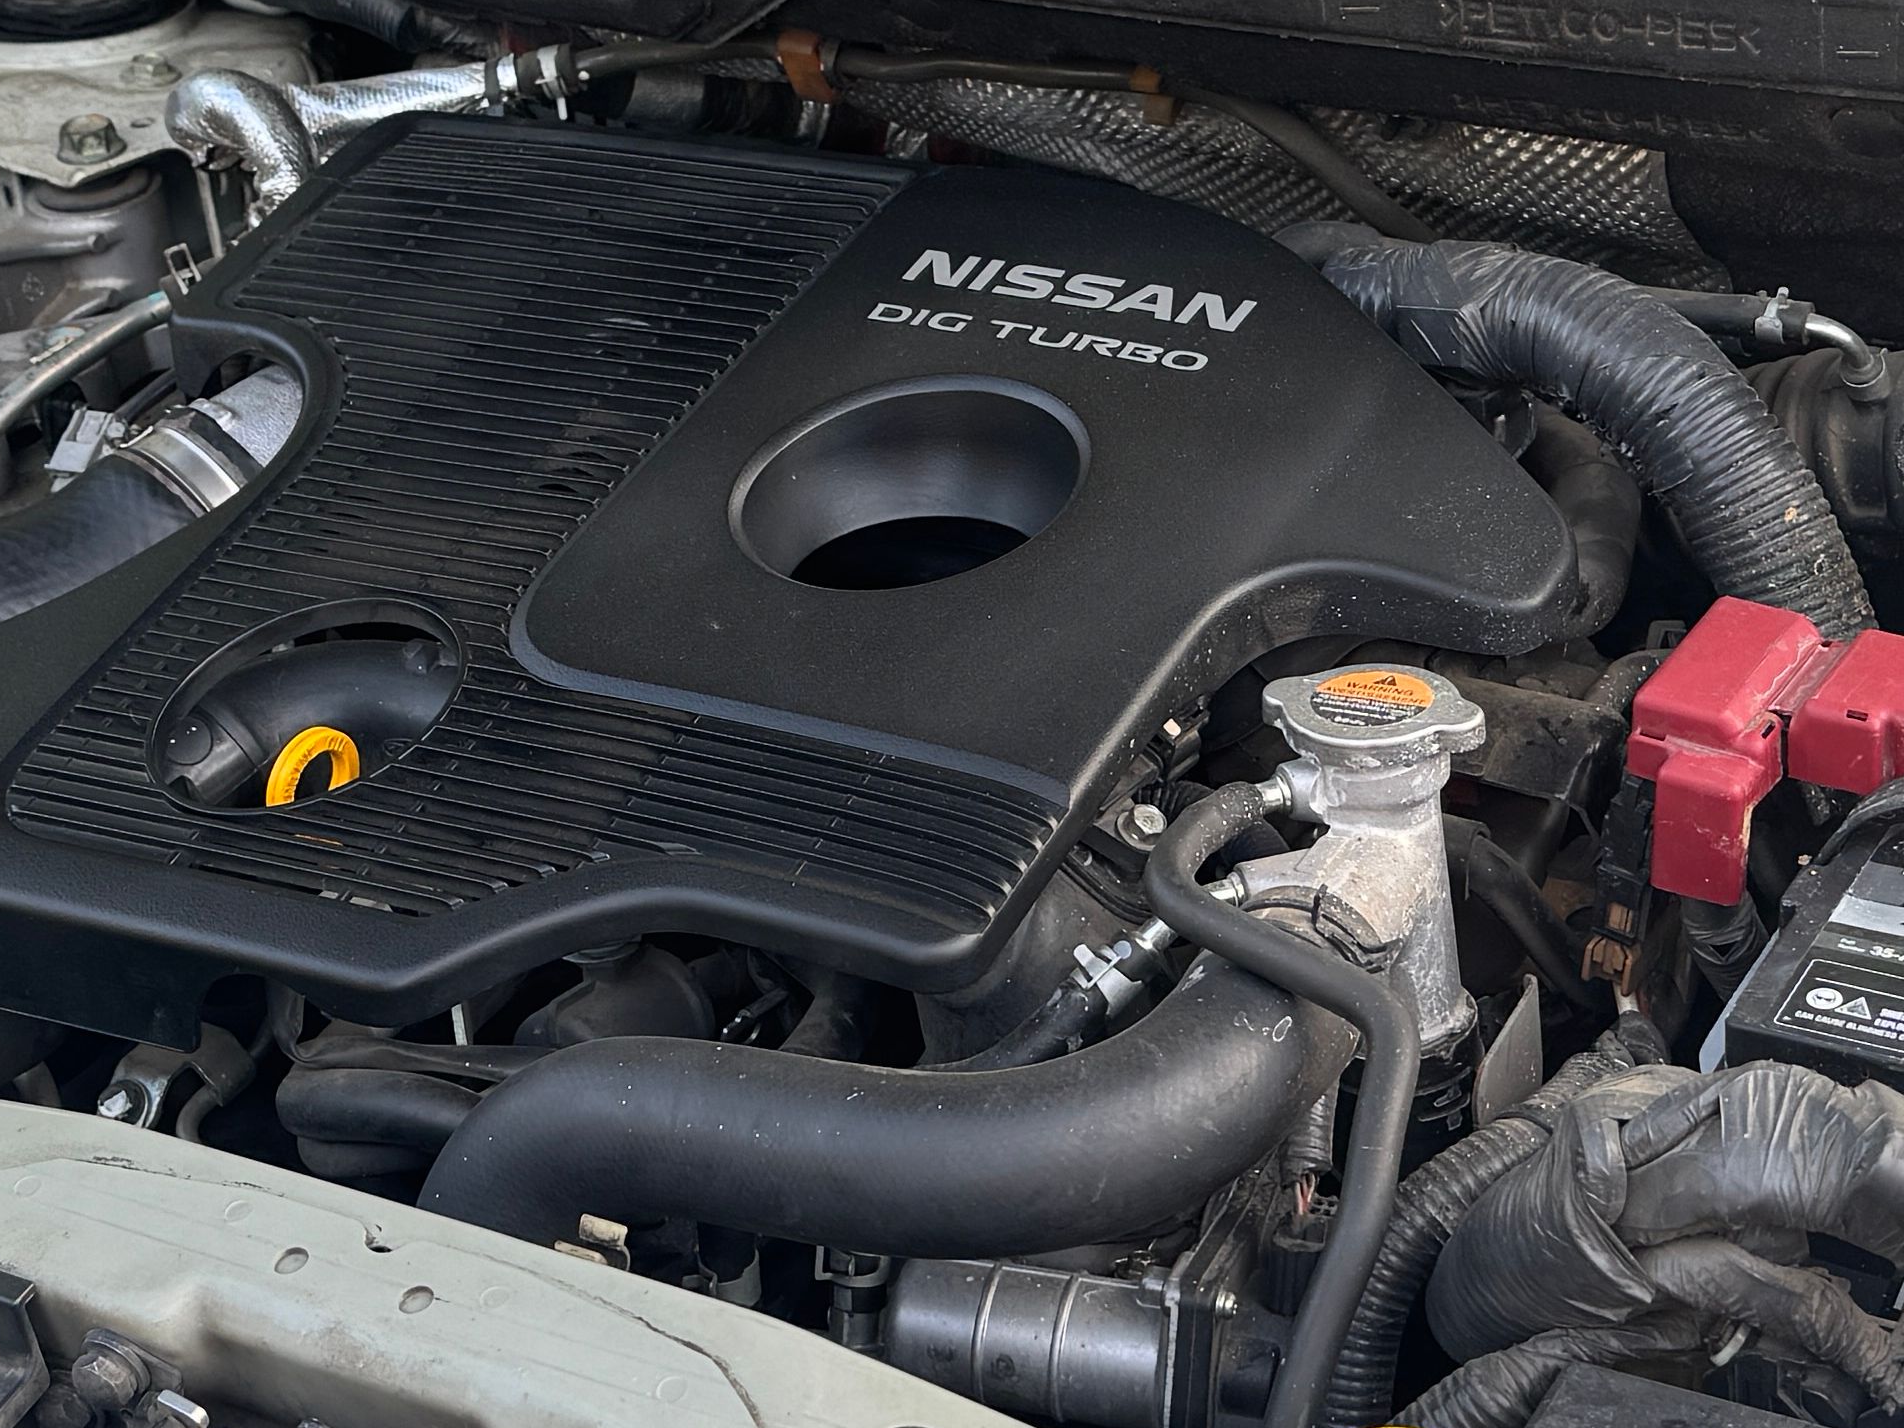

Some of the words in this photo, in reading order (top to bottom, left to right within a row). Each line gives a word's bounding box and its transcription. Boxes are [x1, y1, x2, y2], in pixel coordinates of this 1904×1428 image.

[901, 249, 1258, 333] NISSAN
[867, 302, 974, 333] DIG
[989, 319, 1209, 372] TURBO
[1347, 682, 1414, 696] WARNING
